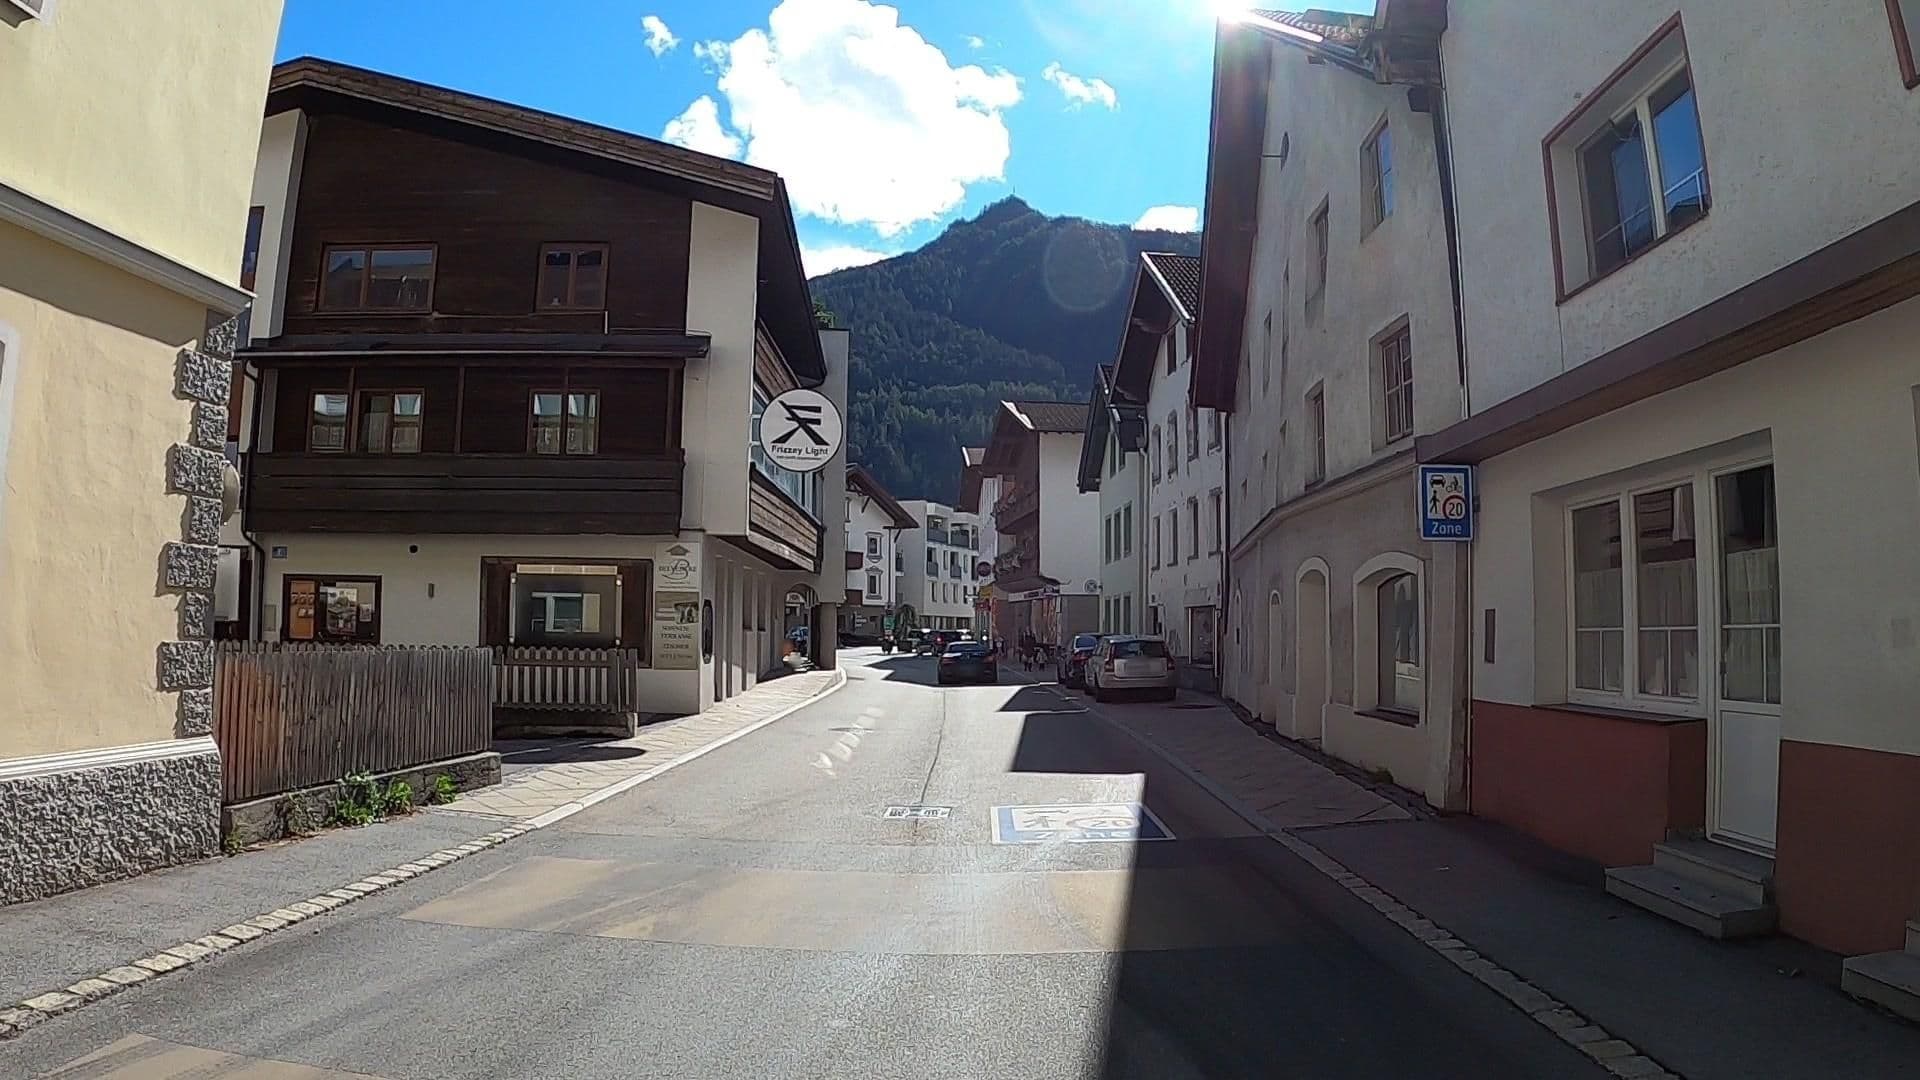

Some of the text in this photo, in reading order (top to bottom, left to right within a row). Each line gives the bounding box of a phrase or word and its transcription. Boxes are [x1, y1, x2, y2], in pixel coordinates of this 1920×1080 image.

[771, 445, 829, 457] Frizzey Light
[1448, 502, 1463, 517] 20
[1431, 521, 1462, 535] Zone
